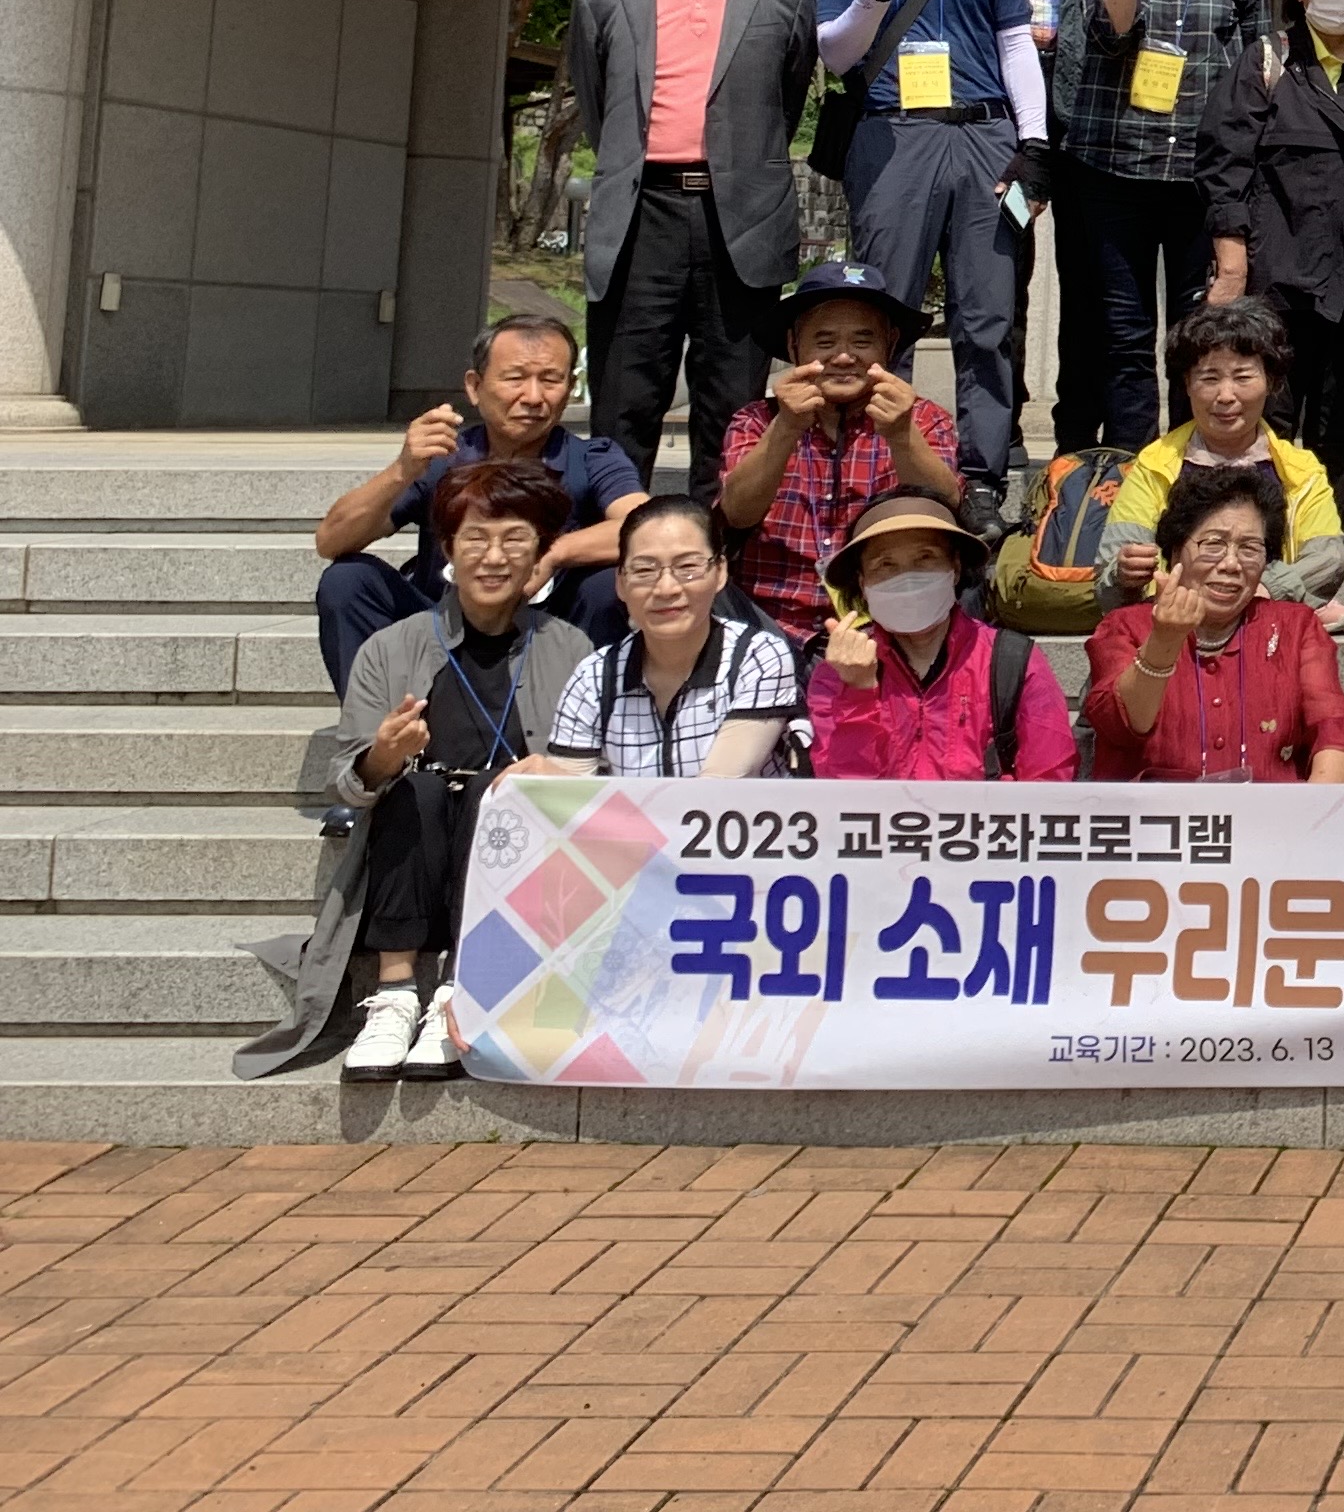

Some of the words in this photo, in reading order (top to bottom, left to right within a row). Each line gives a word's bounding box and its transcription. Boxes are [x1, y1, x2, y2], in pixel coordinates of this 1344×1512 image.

[681, 810, 819, 860] 2023
[837, 811, 1233, 864] 교육강좌프로그램
[670, 874, 848, 1002] 국외
[873, 876, 1056, 1006] 소재
[1048, 1035, 1157, 1063] 교육기간
[1180, 1036, 1262, 1063] 2023.
[1271, 1036, 1295, 1062] 6.
[1304, 1036, 1335, 1061] 13
